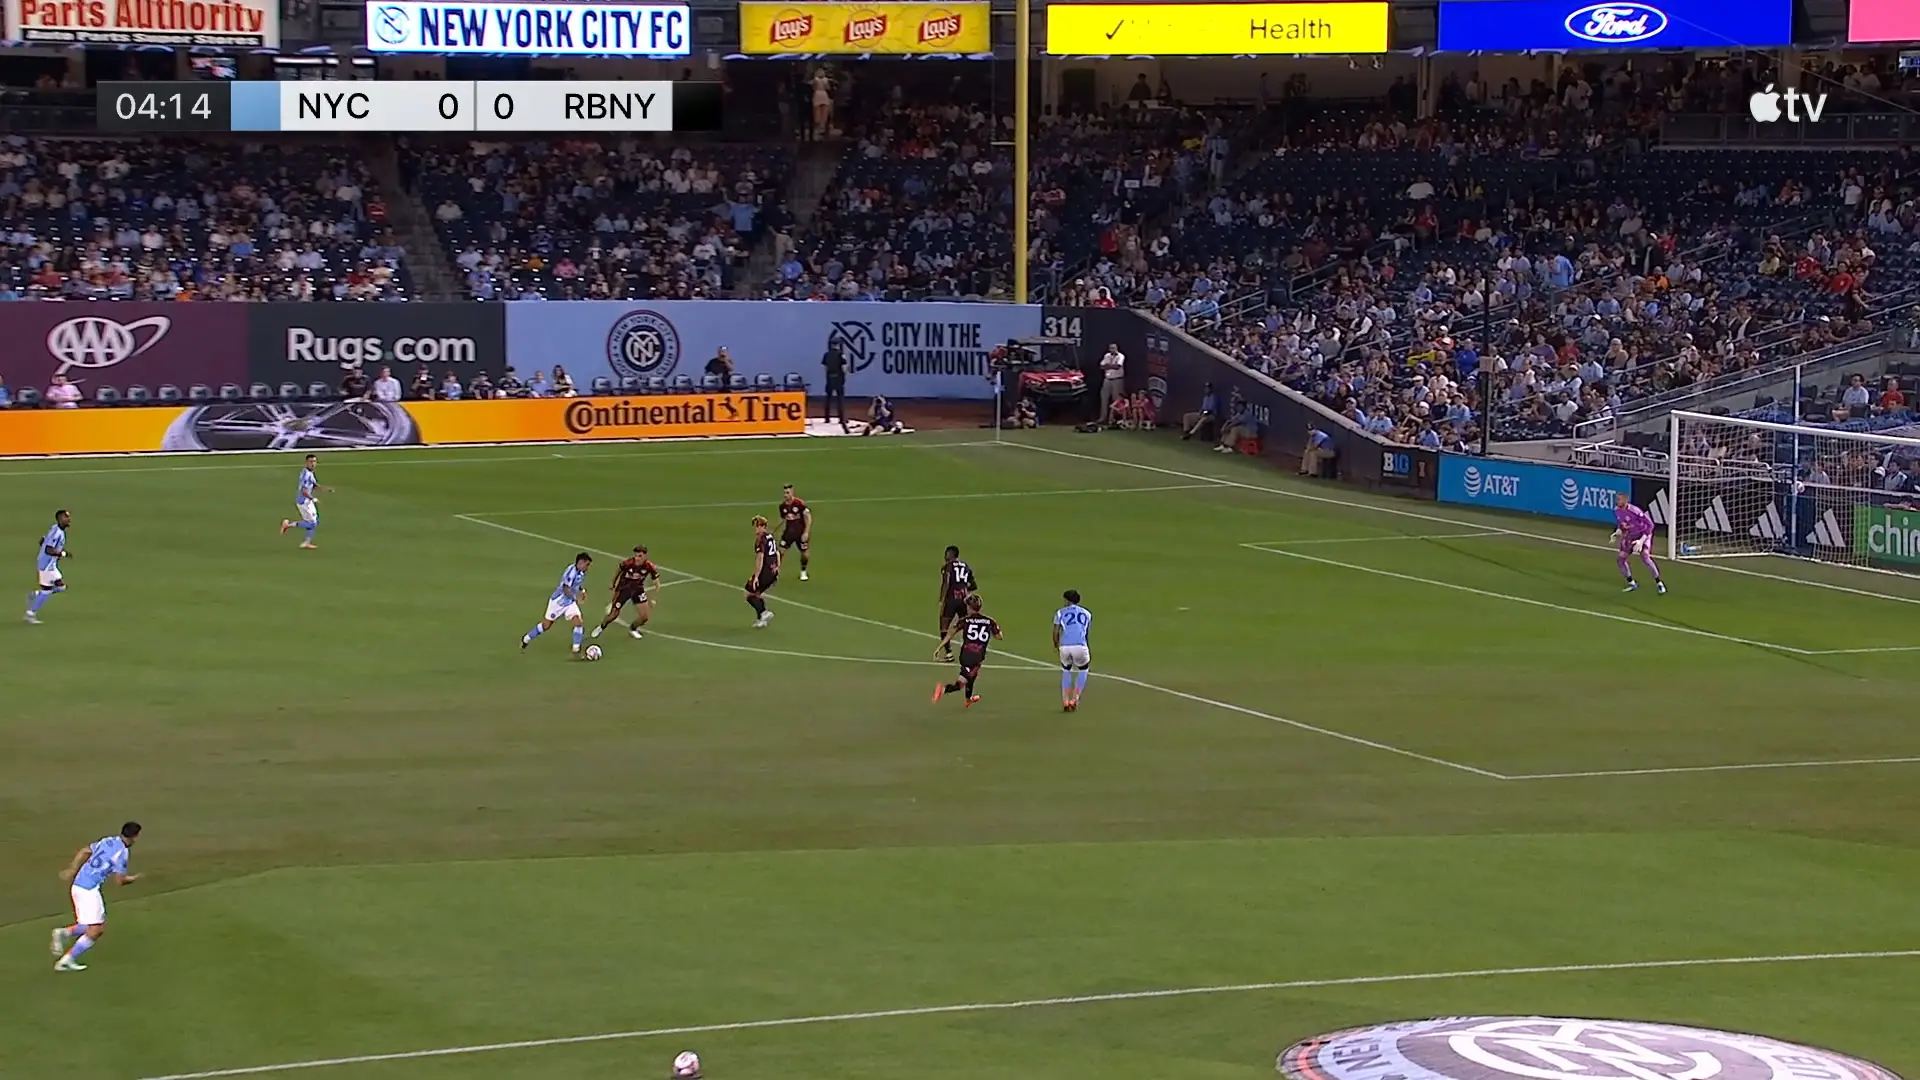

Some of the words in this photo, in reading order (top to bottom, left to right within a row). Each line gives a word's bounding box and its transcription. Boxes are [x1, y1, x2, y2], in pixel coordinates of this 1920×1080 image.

[21, 0, 106, 28] Parts
[115, 0, 266, 32] Authority
[1584, 7, 1648, 37] Ford
[77, 31, 131, 43] Parts
[195, 34, 259, 46] Stores
[420, 8, 487, 46] NEW
[496, 9, 574, 48] YORK
[582, 10, 642, 48] CITY
[651, 11, 683, 49] FC
[1250, 17, 1332, 40] Health
[882, 322, 923, 347] CITY
[926, 322, 948, 348] IN
[951, 323, 982, 348] THE
[1045, 316, 1082, 337] 314
[61, 332, 123, 362] AAA
[287, 327, 476, 367] Rugs.com
[565, 398, 715, 434] Continental
[740, 395, 801, 422] Tire
[1483, 474, 1520, 497] AT&T
[1581, 486, 1618, 510] AT&T
[953, 567, 969, 583] 14
[1064, 611, 1088, 626] 20
[966, 624, 990, 642] 56
